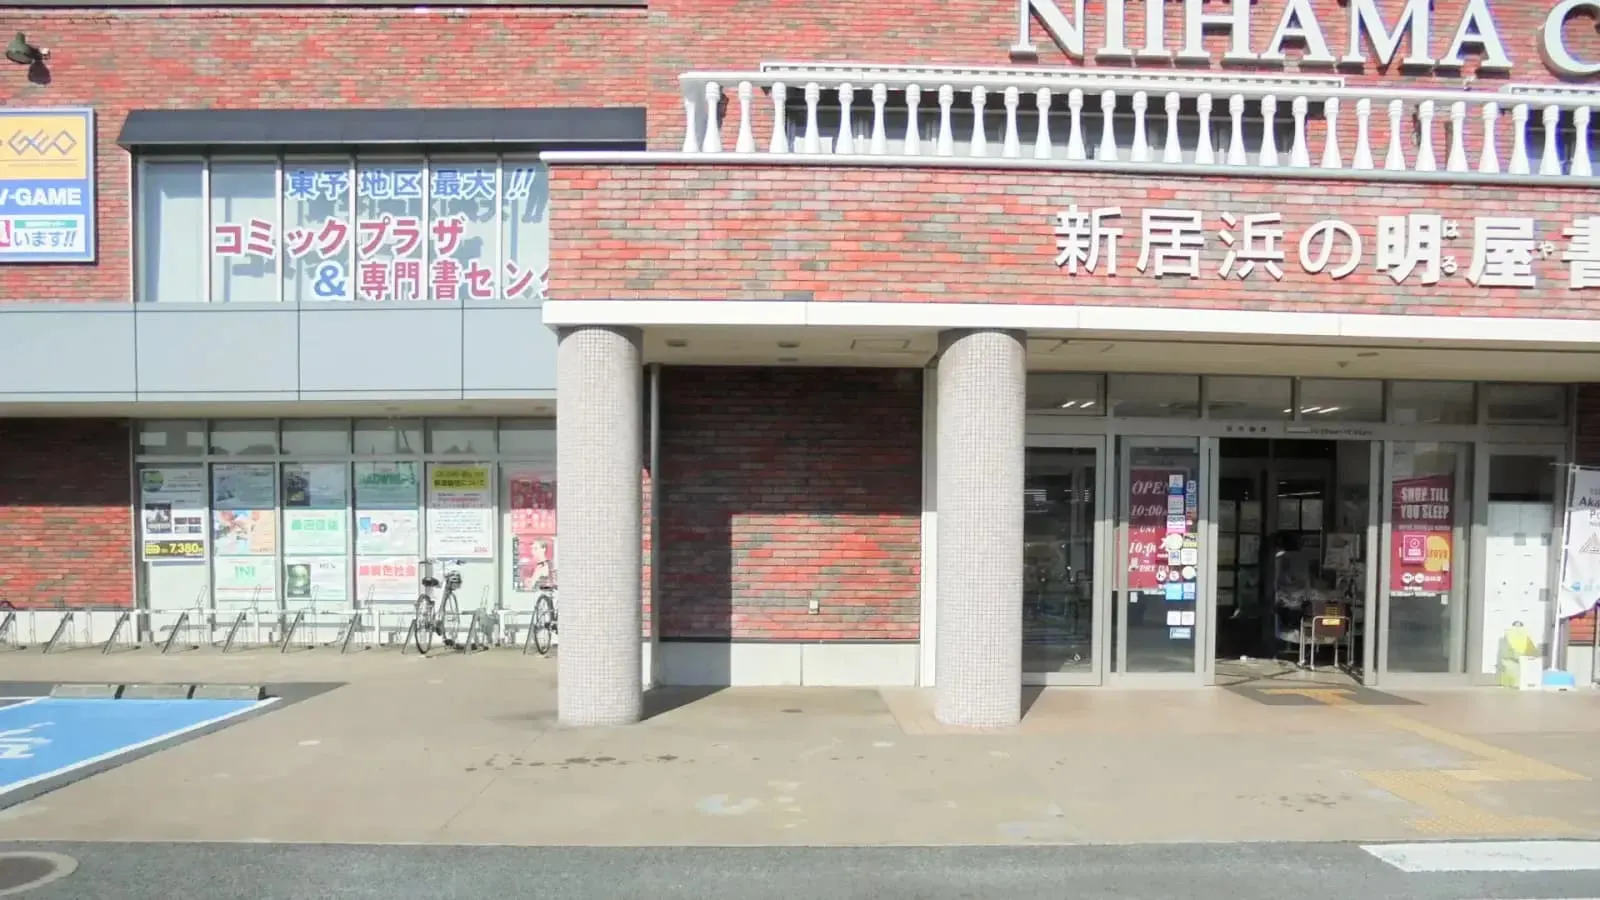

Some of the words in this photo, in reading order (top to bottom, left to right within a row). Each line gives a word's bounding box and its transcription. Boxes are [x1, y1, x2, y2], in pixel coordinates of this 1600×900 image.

[1010, 0, 1513, 67] NIIHAMA
[8, 128, 78, 156] GEO
[215, 216, 465, 256] コミックプラザ
